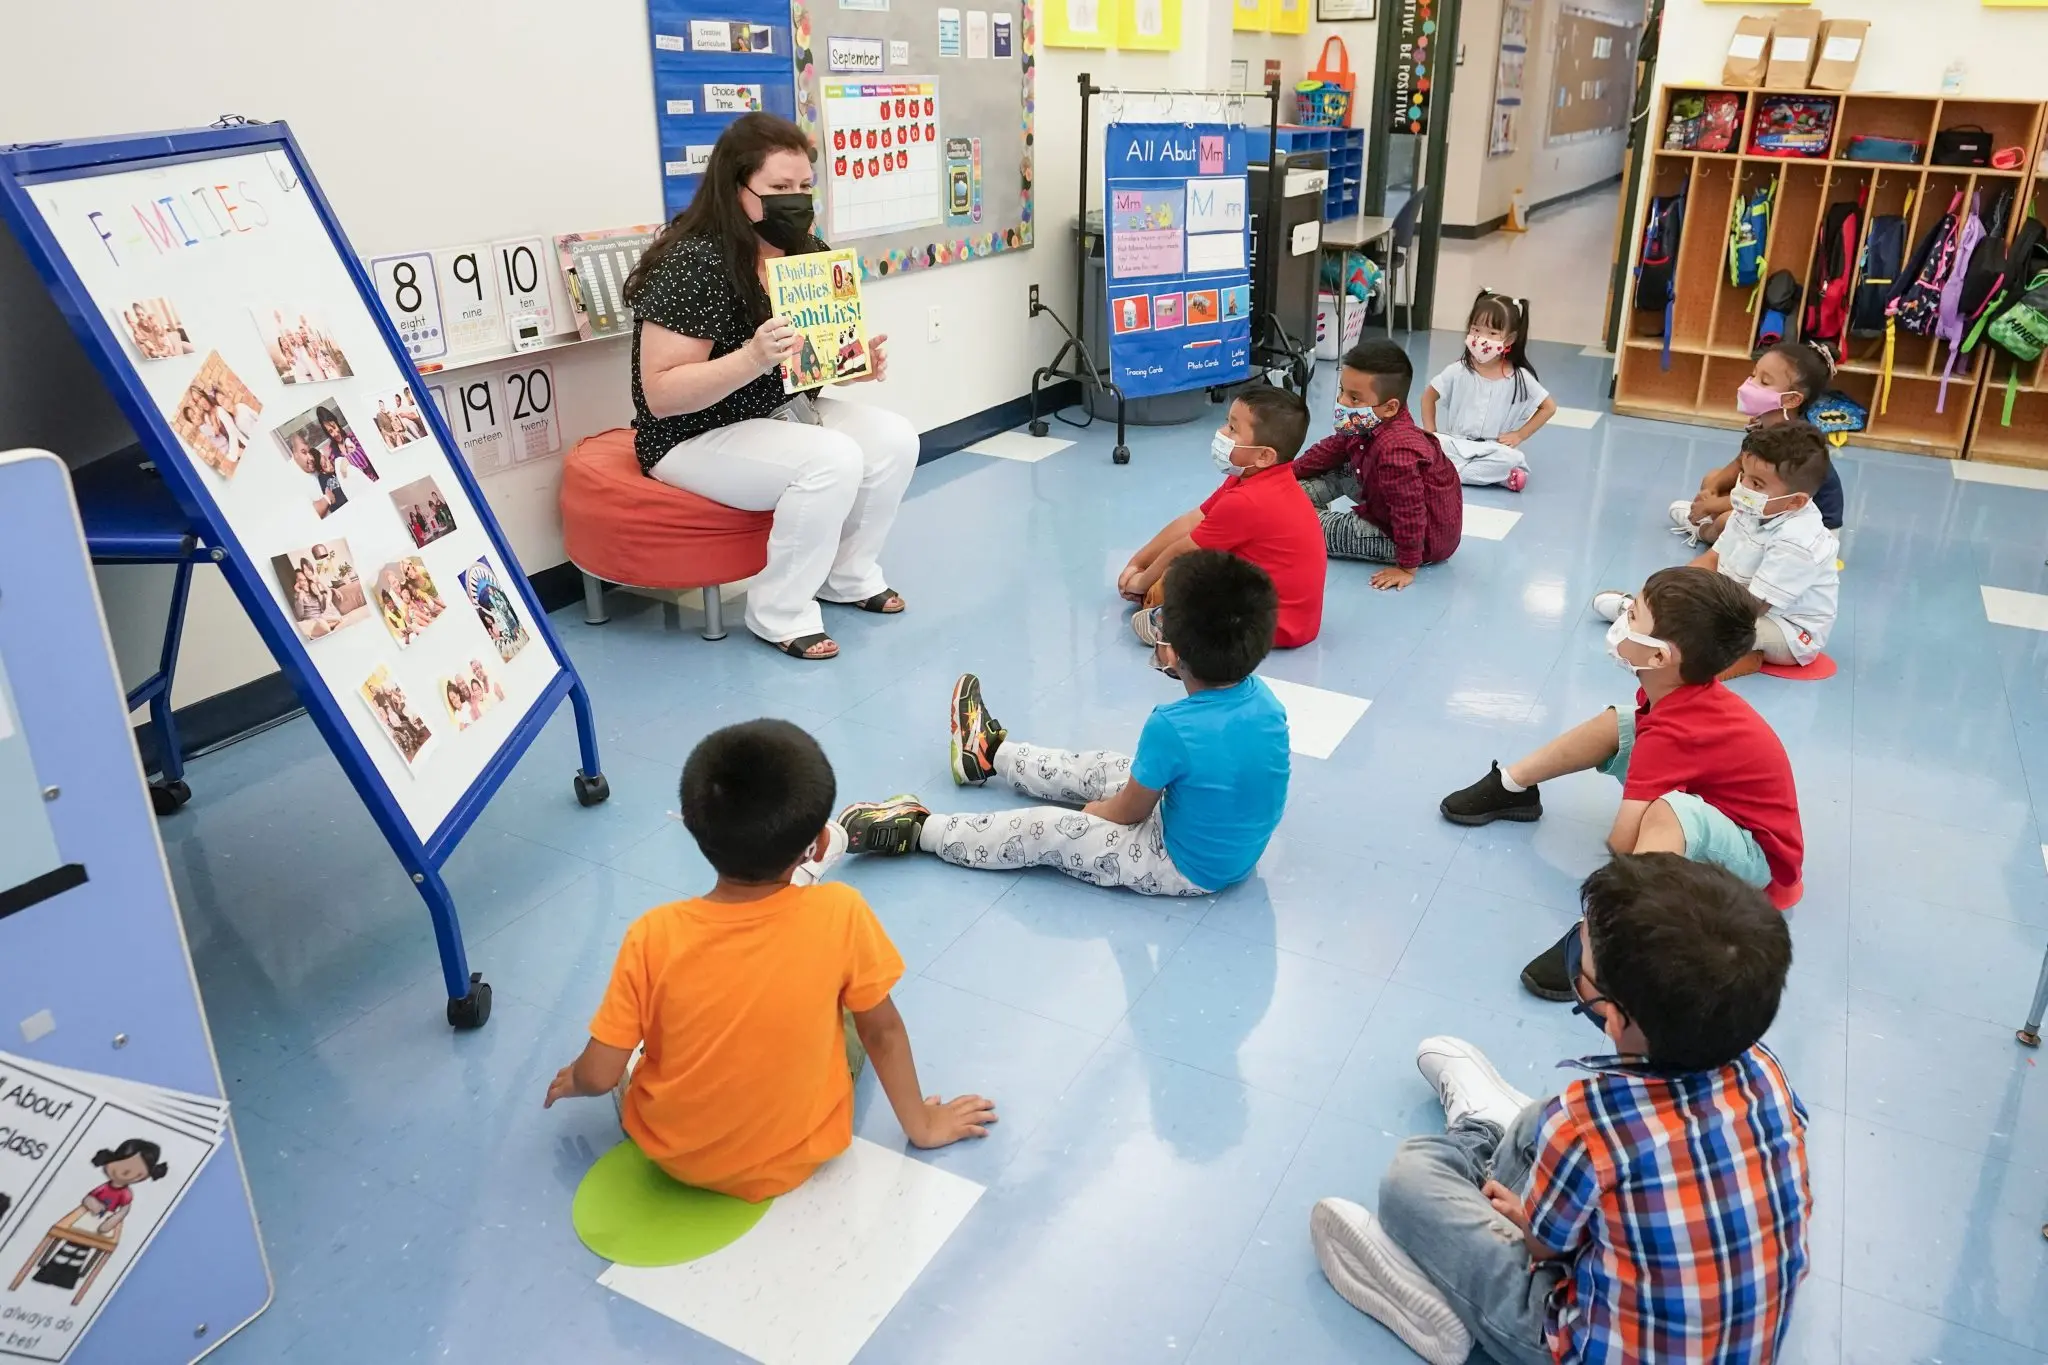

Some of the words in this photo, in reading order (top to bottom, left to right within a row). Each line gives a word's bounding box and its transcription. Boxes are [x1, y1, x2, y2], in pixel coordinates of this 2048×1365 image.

[697, 40, 726, 48] Curriculum
[1400, 44, 1412, 60] BE
[832, 49, 880, 69] September
[711, 86, 735, 96] Choice
[1394, 64, 1410, 128] POSITIVE.
[716, 98, 733, 109] Time
[1126, 139, 1154, 161] All
[1160, 139, 1196, 161] Abut
[1200, 143, 1223, 161] Mm
[691, 153, 711, 164] Lun
[1117, 194, 1141, 209] Mm
[1191, 189, 1214, 217] M
[573, 246, 585, 254] Our
[587, 243, 616, 252] Classroom
[617, 239, 640, 248] Weather
[453, 253, 482, 300] 9
[503, 246, 537, 295] 10
[393, 261, 422, 313] 8
[520, 299, 534, 308] ten
[462, 308, 483, 319] nine
[400, 315, 426, 331] eight
[1187, 361, 1203, 370] Photo
[1204, 359, 1219, 368] Cards
[1231, 359, 1244, 367] Cards
[1125, 367, 1147, 378] Tracing
[1148, 365, 1163, 374] Cards
[507, 368, 551, 420] 20
[460, 381, 495, 432] 19
[520, 418, 549, 432] twenty
[464, 431, 503, 449] nineteen
[2, 1084, 74, 1121] About
[2, 1306, 54, 1331] always
[55, 1316, 74, 1333] do
[6, 1328, 42, 1350] best
